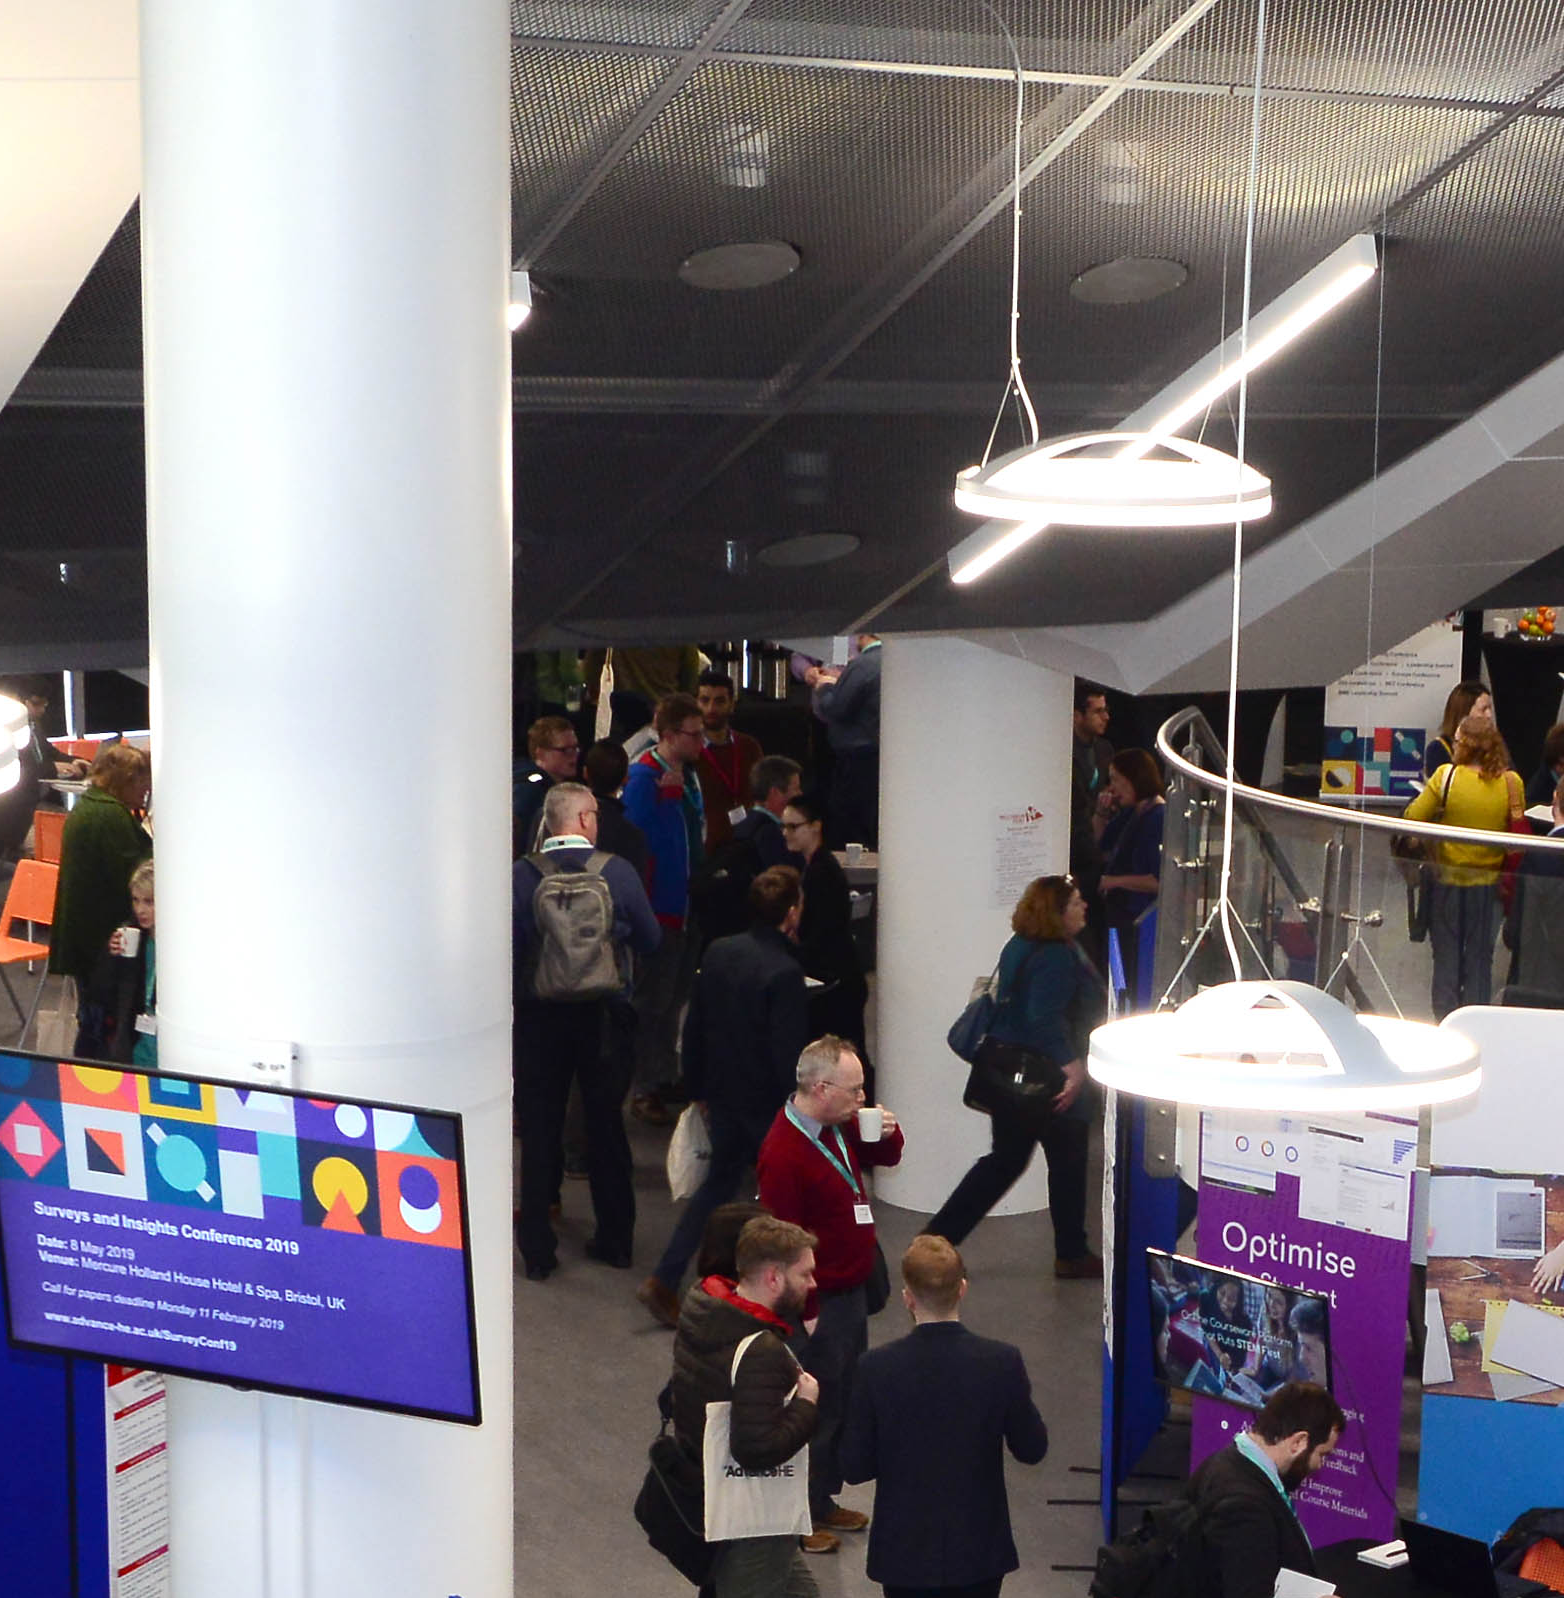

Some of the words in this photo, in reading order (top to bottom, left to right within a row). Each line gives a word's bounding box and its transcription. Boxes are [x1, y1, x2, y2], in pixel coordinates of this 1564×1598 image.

[33, 1200, 91, 1224] Surveys
[92, 1213, 120, 1227] and
[121, 1214, 180, 1237] Insights
[180, 1223, 263, 1250] Conference
[264, 1237, 300, 1256] 2019
[36, 1233, 69, 1250] Date:
[69, 1239, 80, 1251] 8
[80, 1240, 105, 1258] May
[105, 1245, 136, 1261] 2019
[1222, 1221, 1356, 1279] Optimise
[37, 1249, 80, 1267] Venue:
[80, 1256, 128, 1276] Mercure
[128, 1264, 171, 1282] Holland
[173, 1271, 211, 1289] House
[211, 1277, 242, 1294] Hotel
[244, 1283, 255, 1296] &
[255, 1285, 283, 1302] Spa,
[284, 1289, 325, 1309] Bristol,
[326, 1296, 347, 1311] UK
[41, 1281, 62, 1295] Call
[63, 1284, 77, 1297] for
[77, 1288, 112, 1304] papers
[113, 1293, 155, 1310] deadline
[156, 1299, 197, 1319] Monday
[198, 1307, 210, 1319] 11
[211, 1309, 258, 1329] February
[258, 1316, 285, 1331] 2019
[1209, 1317, 1257, 1338] Courseware
[724, 1464, 795, 1478] AdceHE
[1308, 1478, 1343, 1497] Improve
[1299, 1490, 1330, 1508] Course
[1331, 1499, 1368, 1519] Materials
